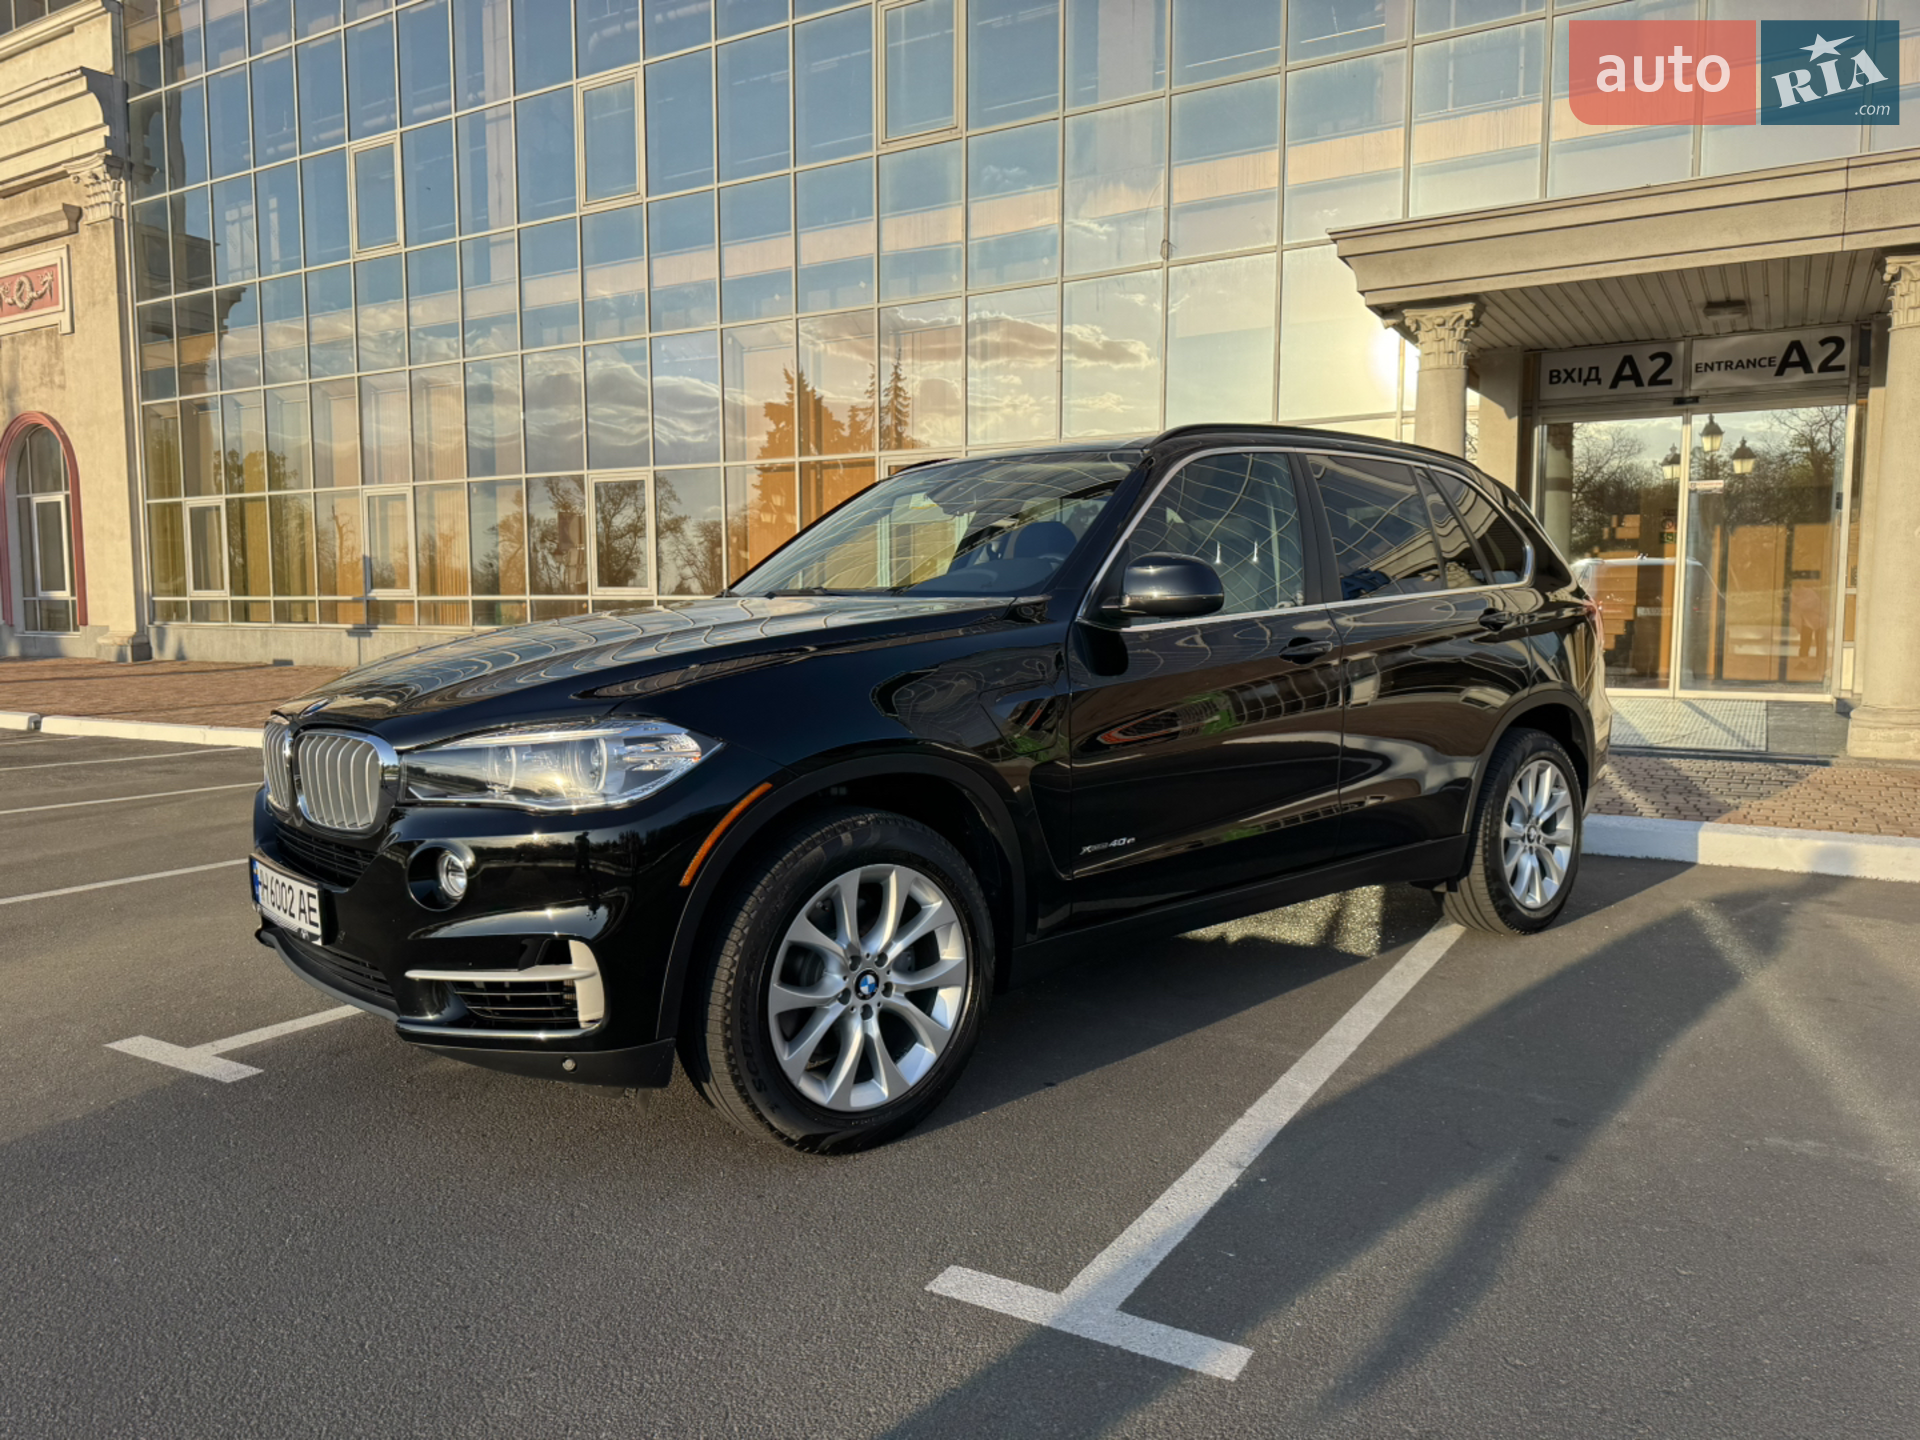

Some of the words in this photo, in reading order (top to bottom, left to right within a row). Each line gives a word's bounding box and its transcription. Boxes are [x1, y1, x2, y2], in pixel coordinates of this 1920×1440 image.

[1549, 366, 1602, 386] ВХІД
[1608, 351, 1673, 389] А2
[1694, 355, 1778, 374] ENTRANCE
[1774, 335, 1846, 377] A2
[270, 875, 296, 919] 6002
[298, 888, 320, 929] AE
